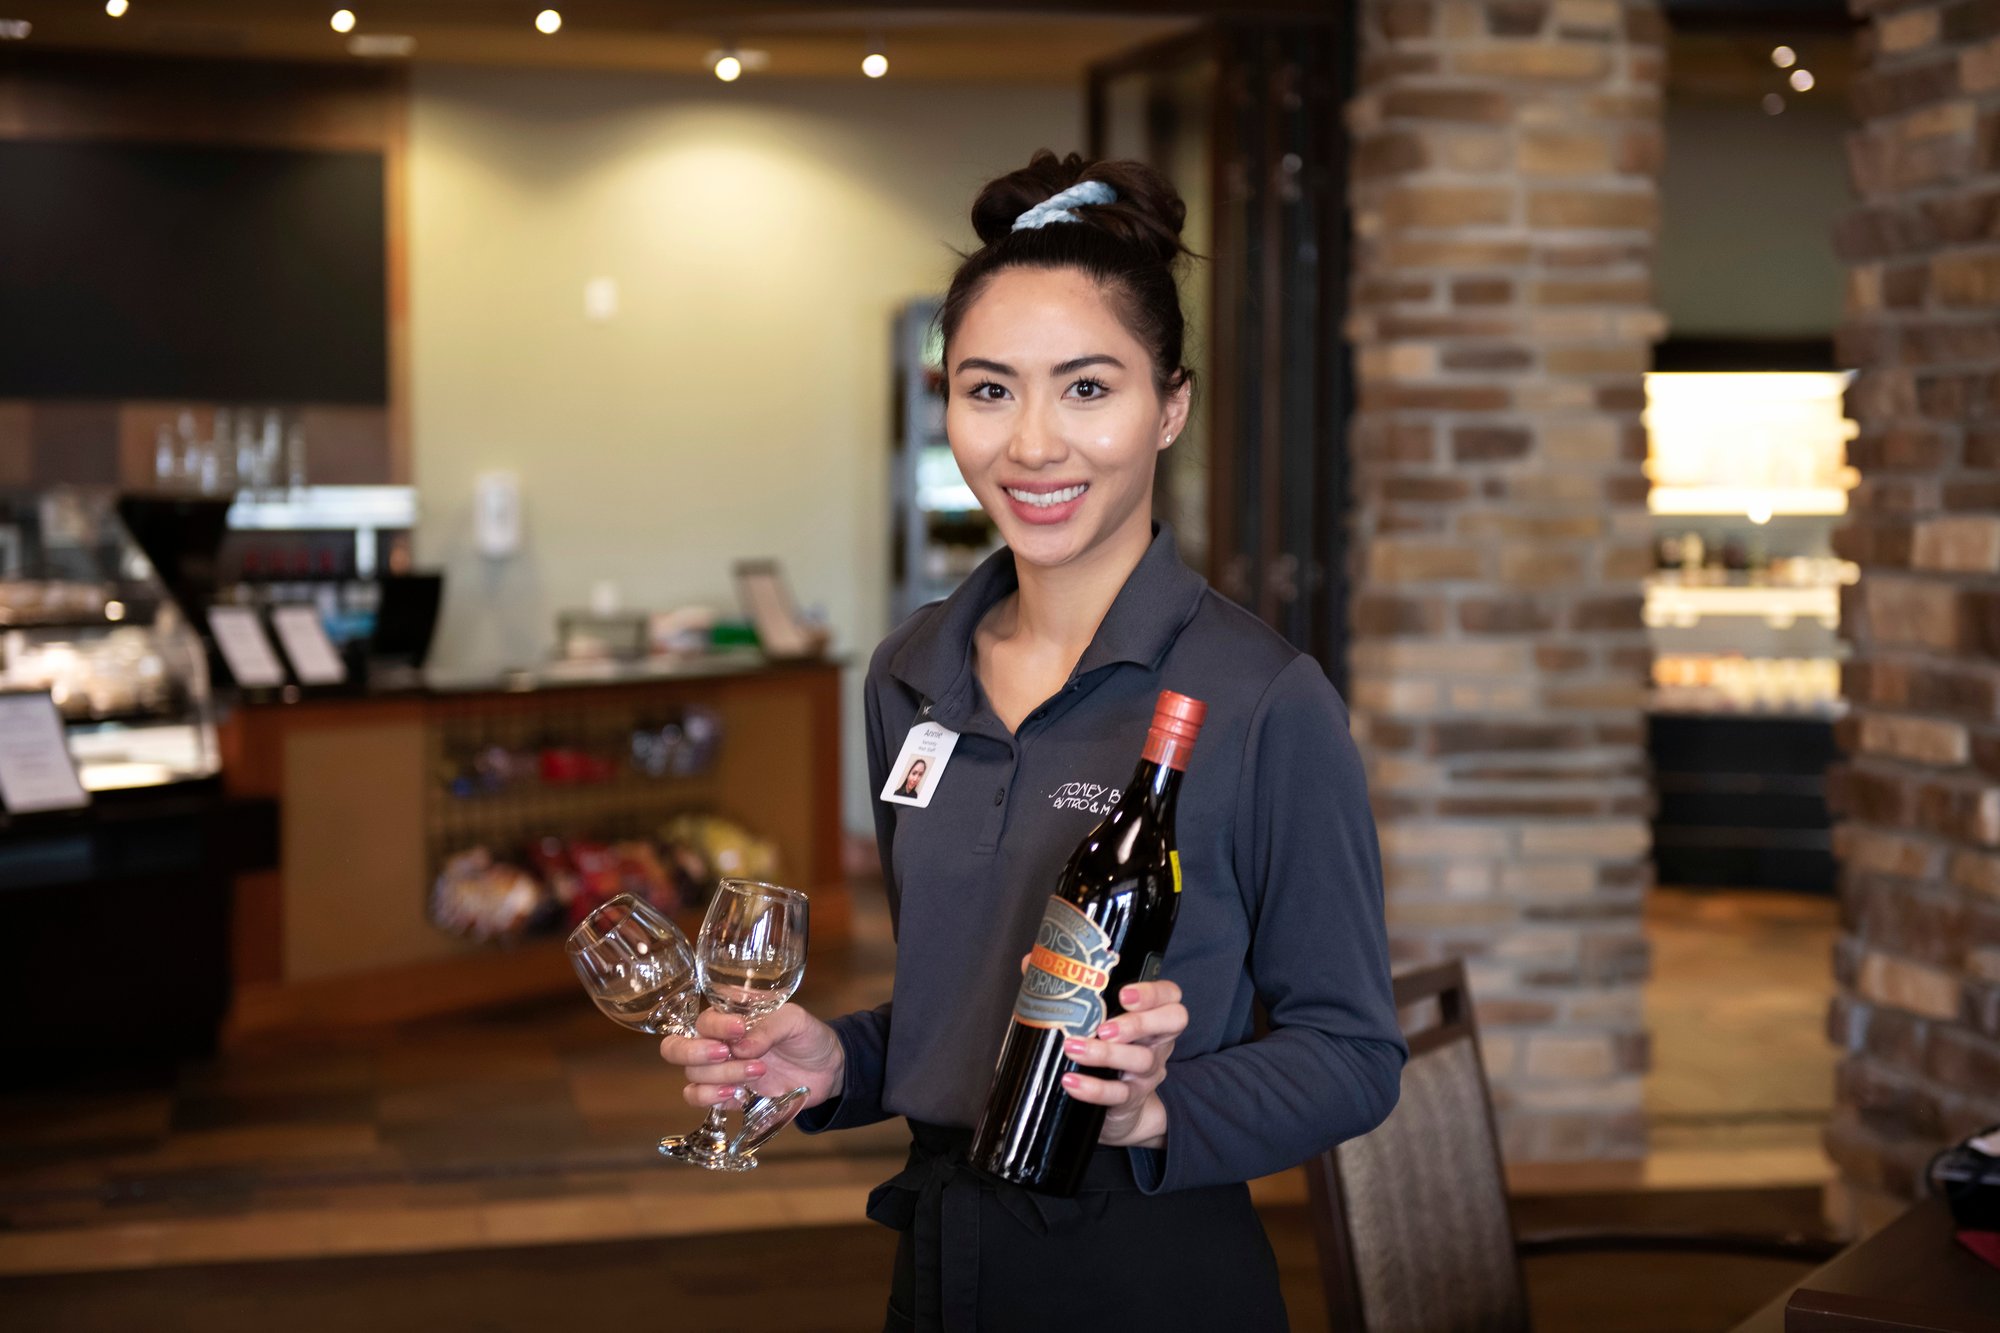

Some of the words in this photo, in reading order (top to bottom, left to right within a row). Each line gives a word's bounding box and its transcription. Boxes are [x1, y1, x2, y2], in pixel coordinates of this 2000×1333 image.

[1048, 782, 1109, 800] STONEY
[1108, 789, 1125, 804] B
[1053, 797, 1090, 810] BISTRO
[1090, 801, 1099, 813] &
[1100, 804, 1114, 815] M
[1037, 922, 1076, 957] 019
[1027, 966, 1067, 995] FORNIA
[1033, 949, 1098, 987] NDRUM
